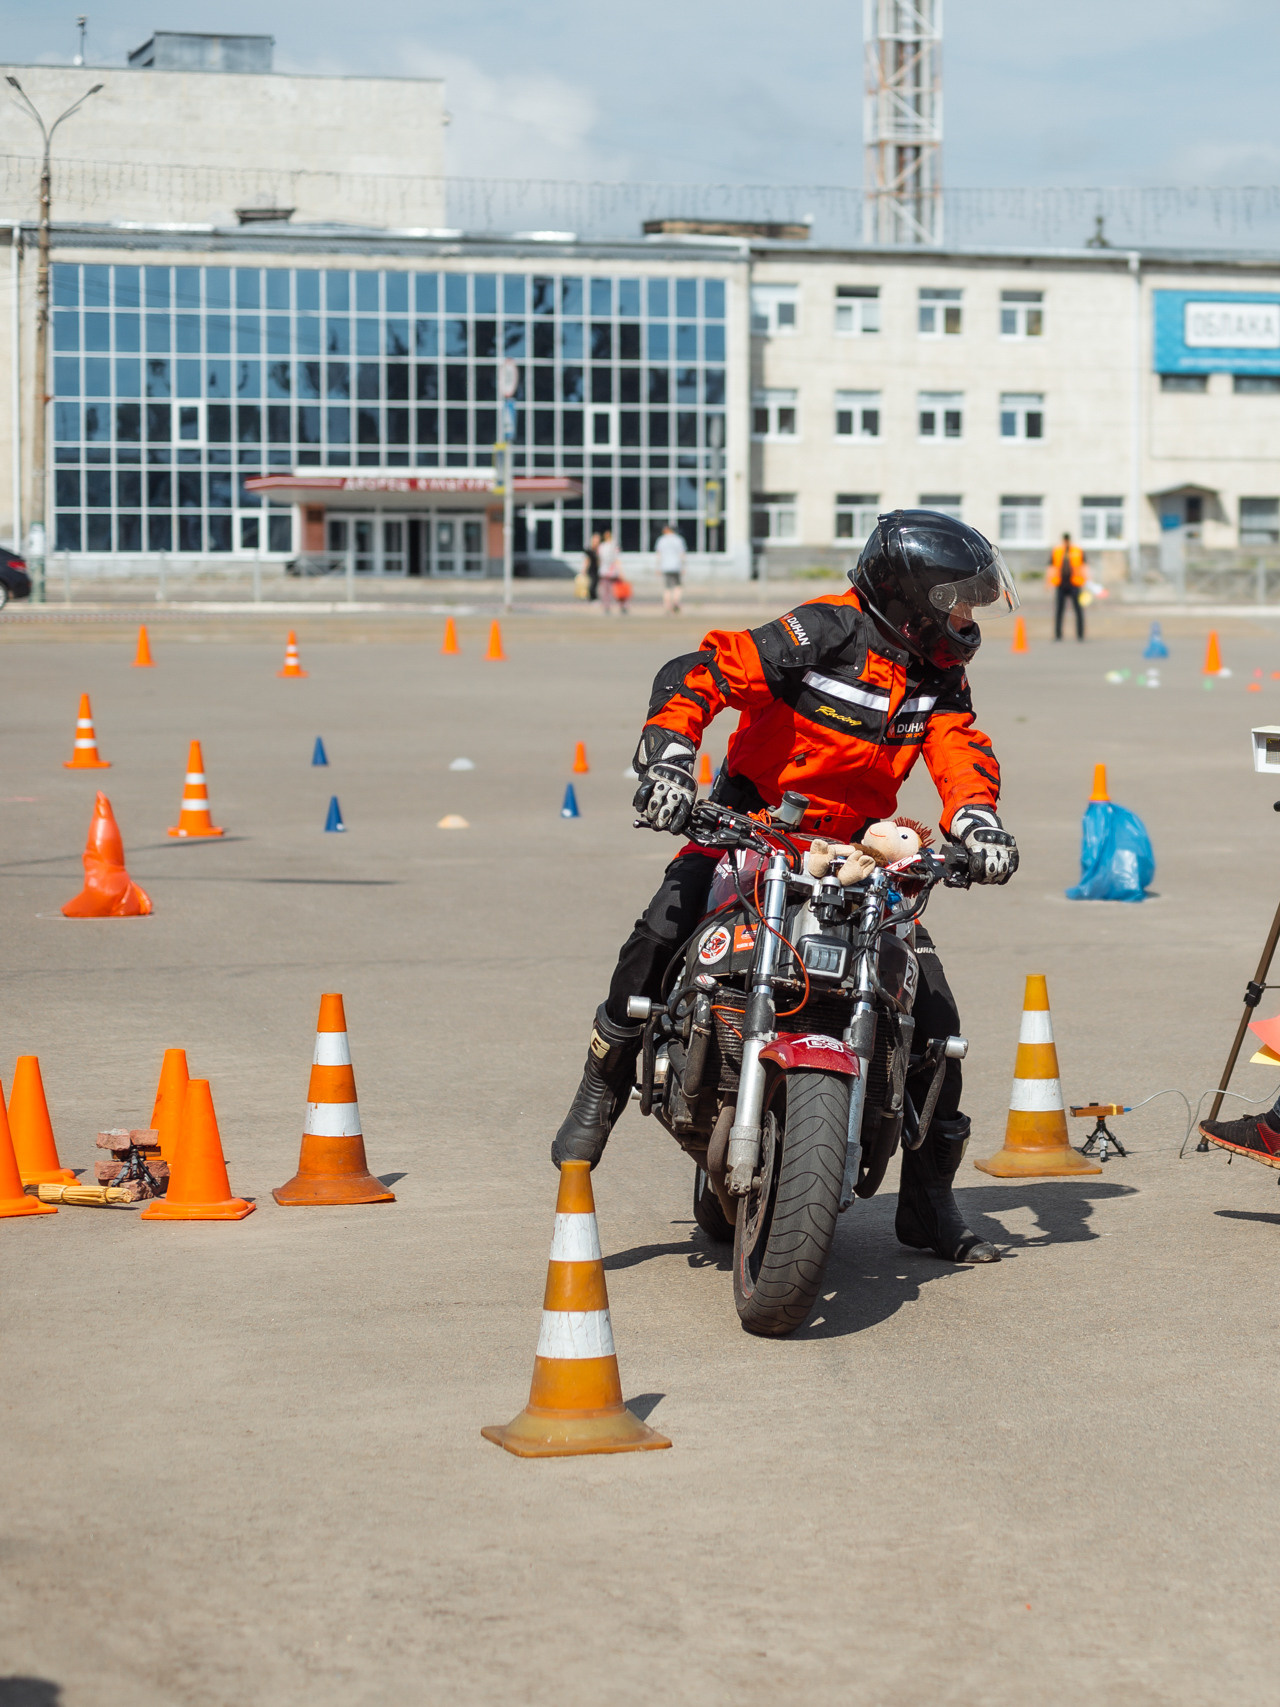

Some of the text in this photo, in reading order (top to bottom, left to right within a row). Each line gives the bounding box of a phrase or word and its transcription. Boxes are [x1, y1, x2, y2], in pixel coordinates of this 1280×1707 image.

[787, 616, 811, 646] DUHAN
[815, 705, 862, 727] Racing
[914, 946, 935, 954] UHA
